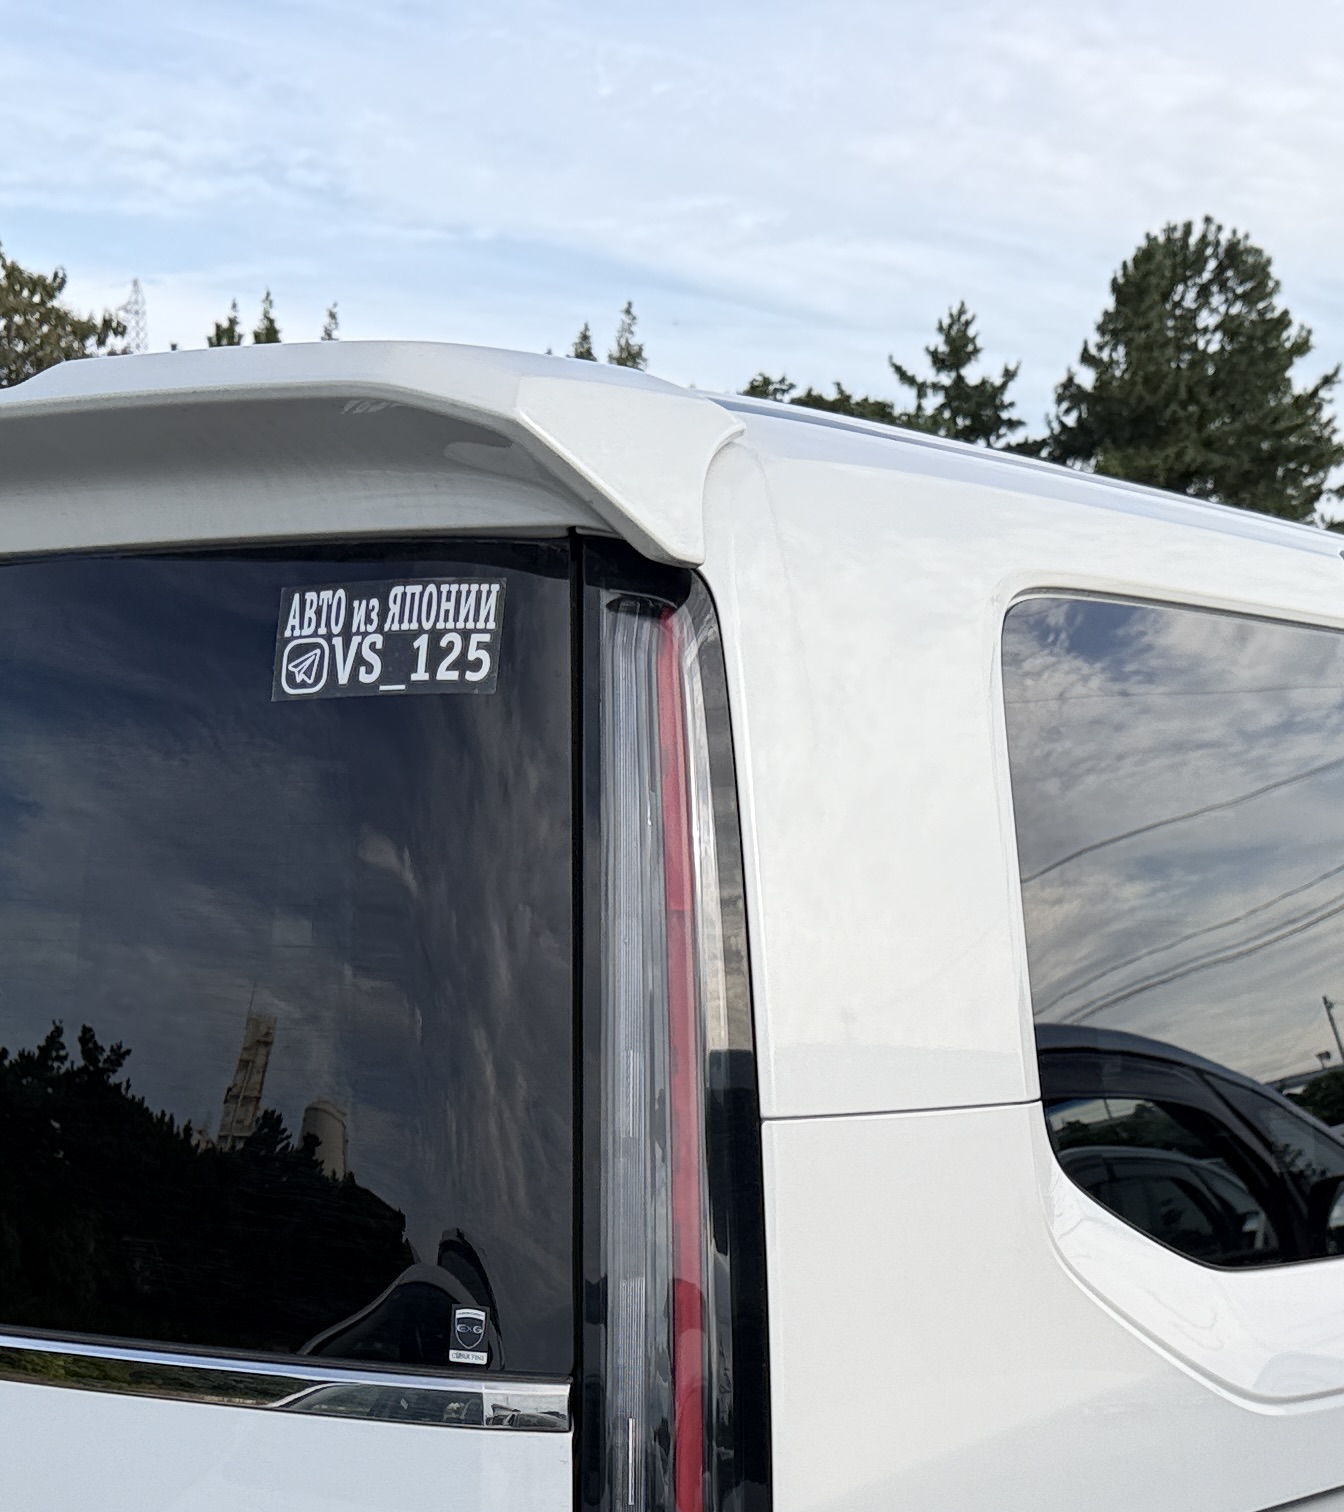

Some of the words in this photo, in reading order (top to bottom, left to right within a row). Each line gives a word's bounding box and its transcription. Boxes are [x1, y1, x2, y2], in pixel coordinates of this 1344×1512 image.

[284, 588, 346, 638] АВТО
[352, 598, 379, 633] из
[384, 584, 500, 632] ЯПОНИИ
[332, 632, 492, 691] VS_125
